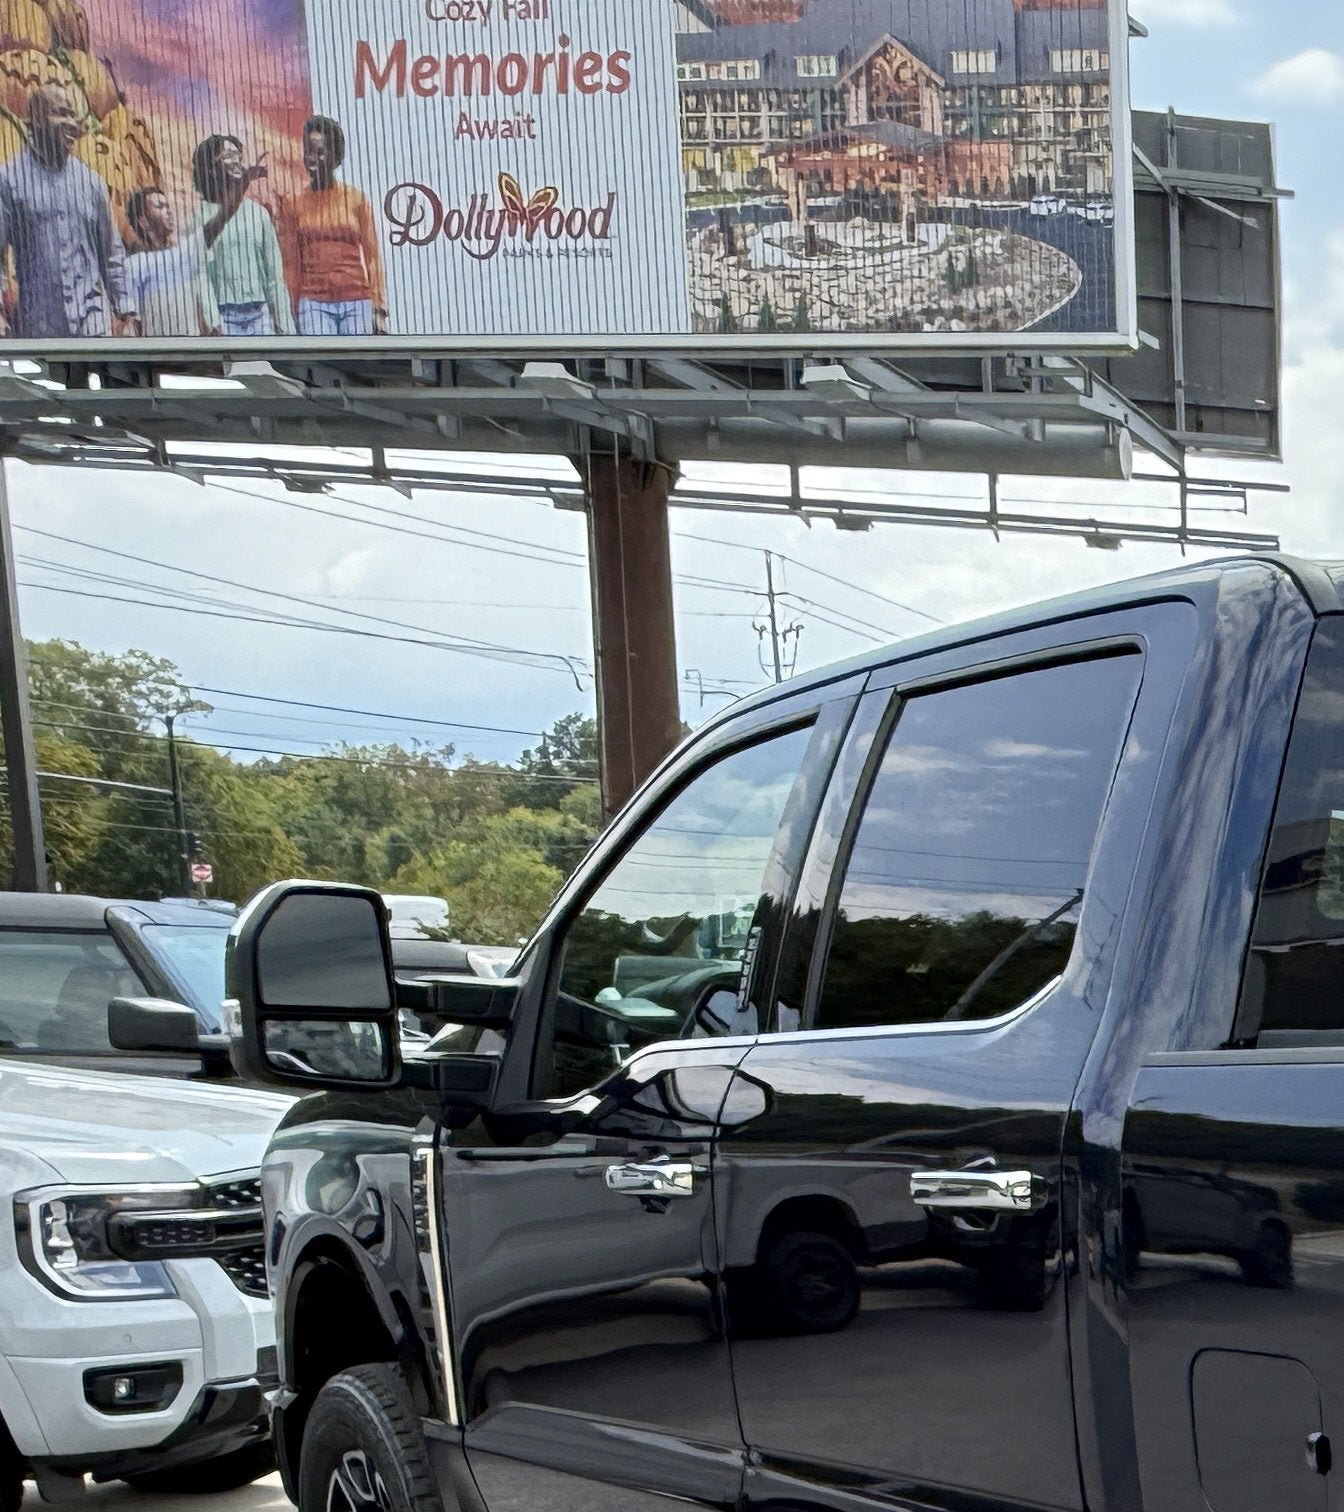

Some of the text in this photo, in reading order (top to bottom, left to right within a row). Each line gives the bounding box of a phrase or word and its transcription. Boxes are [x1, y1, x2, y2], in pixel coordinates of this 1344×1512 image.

[425, 0, 549, 27] Cozy Fall
[355, 33, 632, 99] Memories
[454, 111, 537, 141] Await
[384, 173, 617, 261] Dollywood
